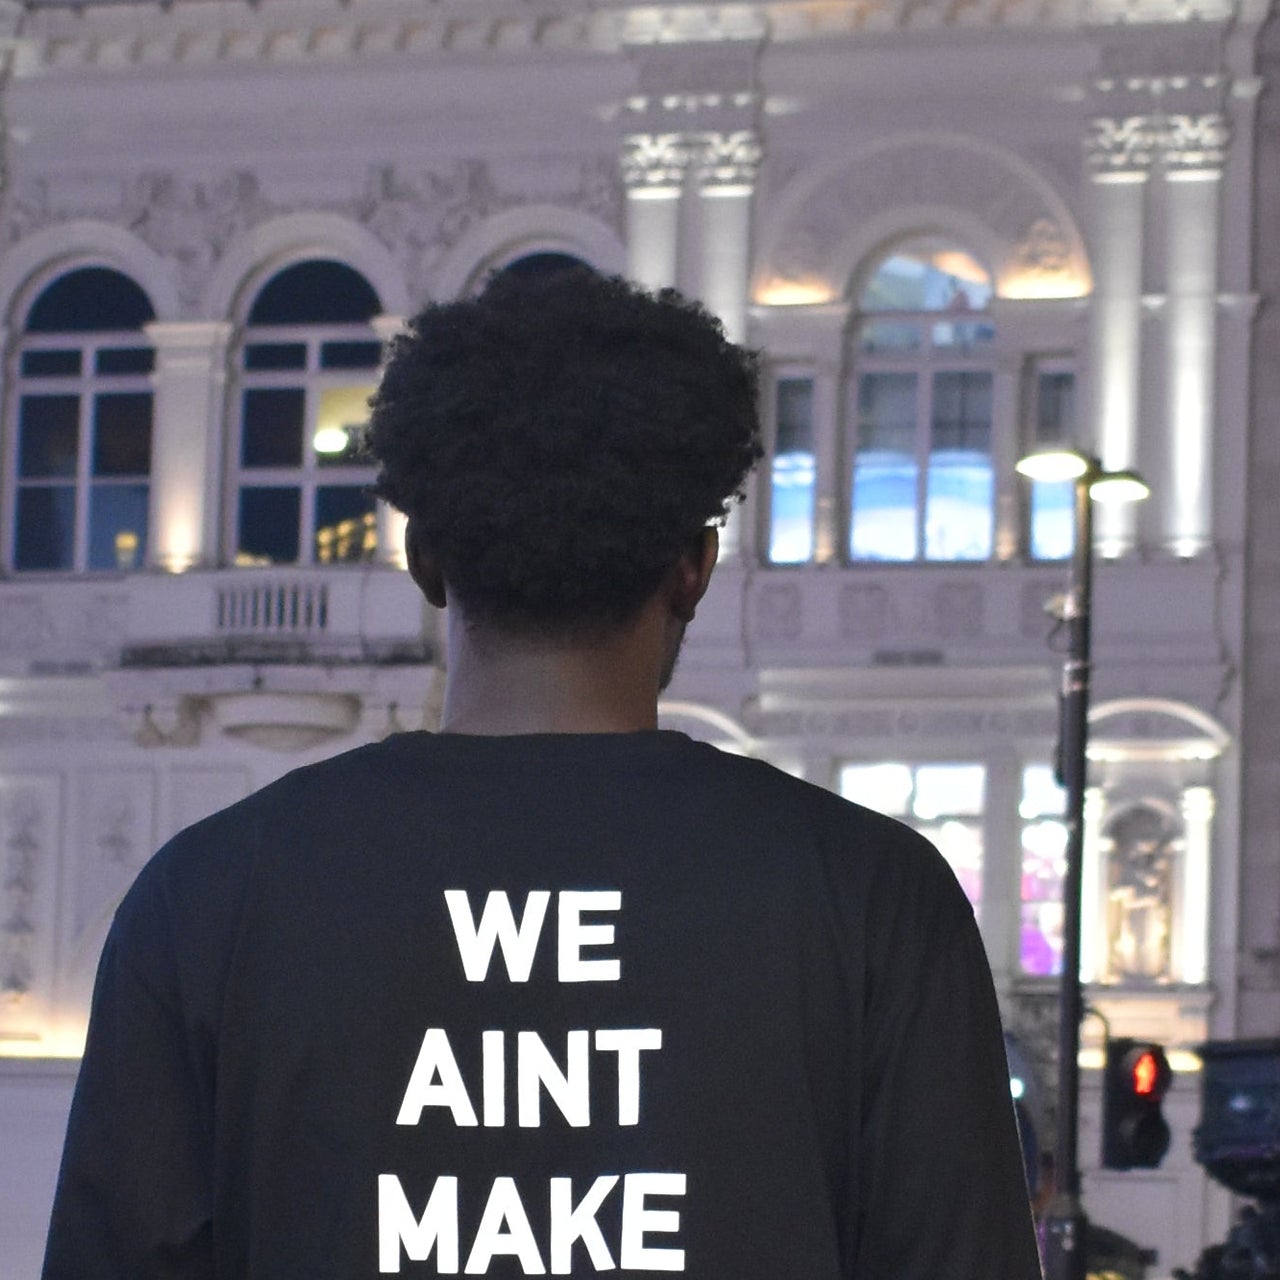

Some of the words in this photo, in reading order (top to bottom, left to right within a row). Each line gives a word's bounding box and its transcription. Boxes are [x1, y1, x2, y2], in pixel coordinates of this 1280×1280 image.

[444, 890, 621, 982] WE
[396, 1028, 662, 1127] AINT
[378, 1173, 686, 1274] MAKE
